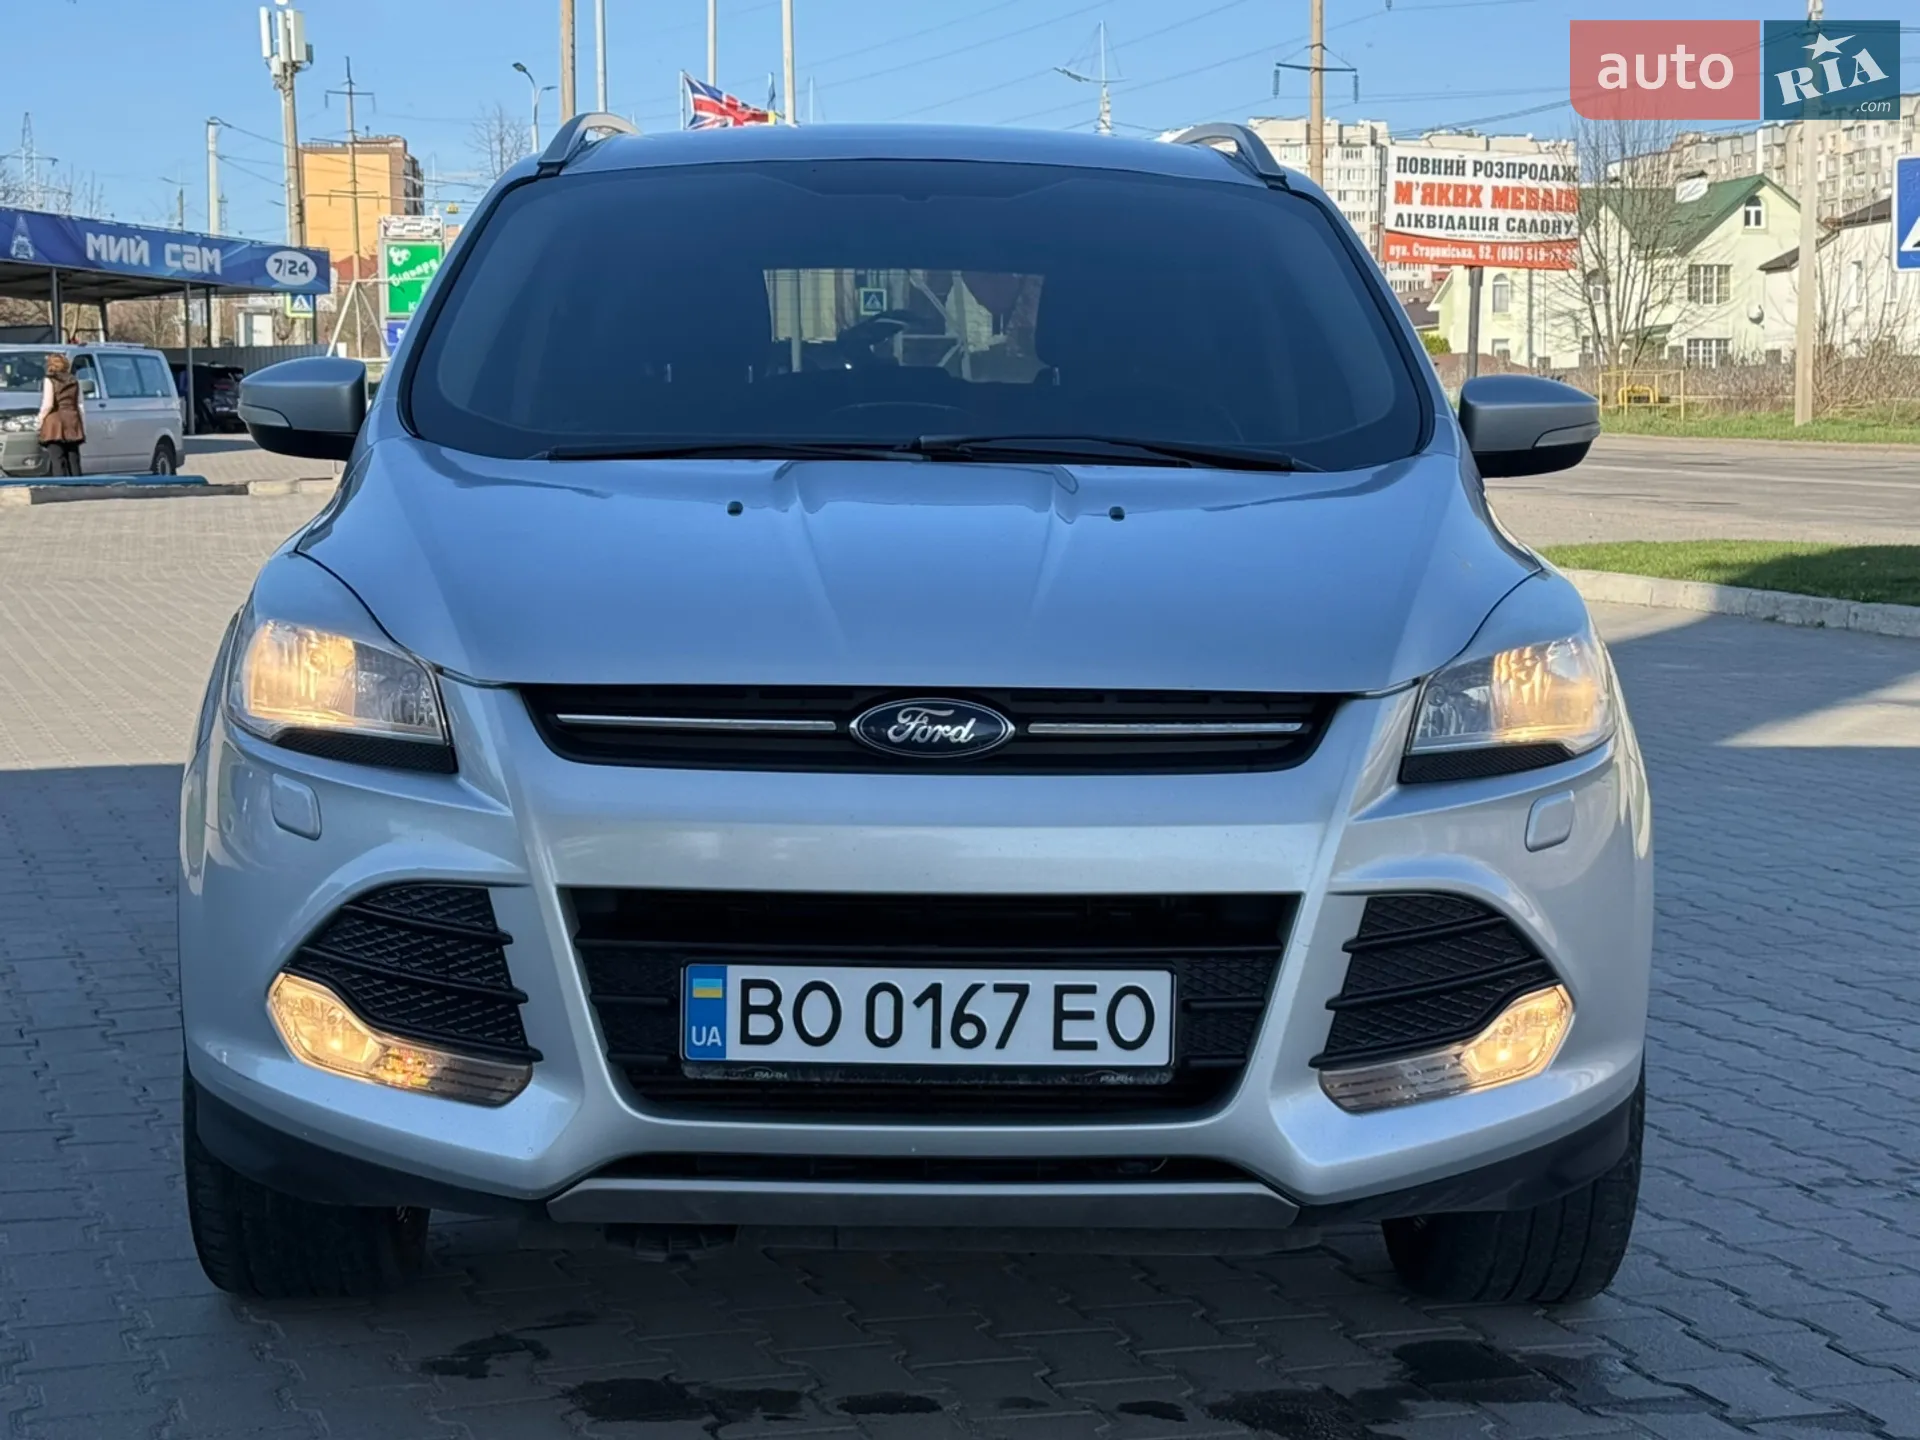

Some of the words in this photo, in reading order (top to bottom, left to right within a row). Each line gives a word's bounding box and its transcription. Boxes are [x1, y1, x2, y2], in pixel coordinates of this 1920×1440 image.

[1396, 155, 1467, 177] ПОВНИЙ
[1472, 160, 1578, 182] РОЗПРОДАЖ
[1395, 212, 1499, 231] ЛІКВІДАЦІЯ
[1506, 217, 1574, 235] САЛОНУ
[86, 232, 150, 267] МИЙ
[273, 258, 310, 276] 7/24
[887, 707, 976, 743] Ford
[865, 981, 1031, 1050] 0167
[691, 1026, 722, 1047] UA
